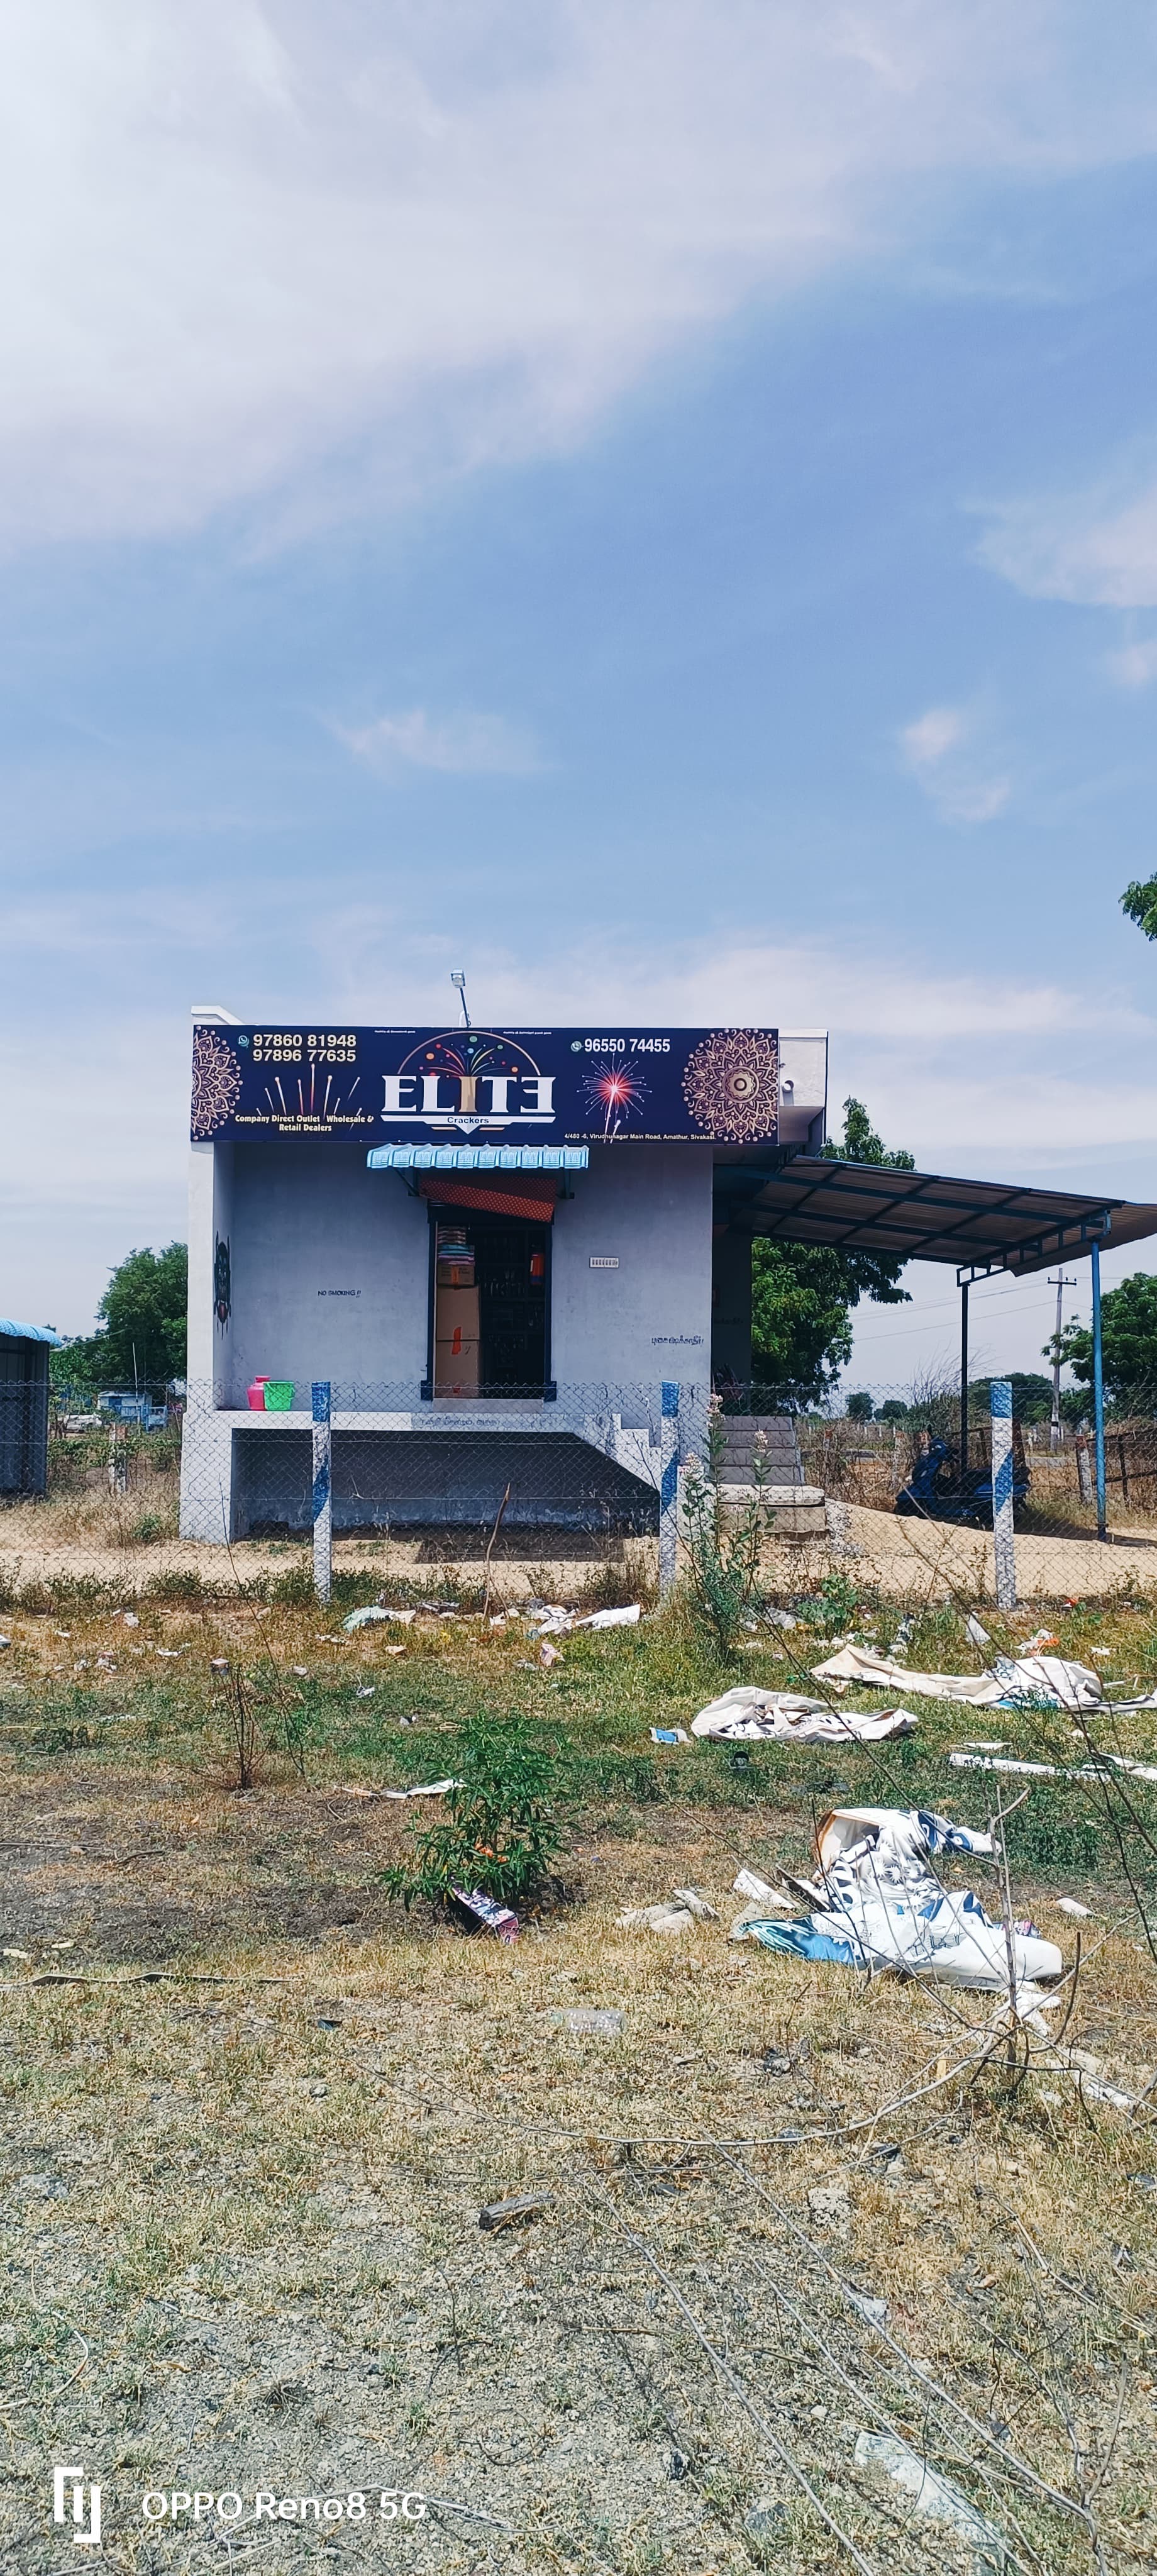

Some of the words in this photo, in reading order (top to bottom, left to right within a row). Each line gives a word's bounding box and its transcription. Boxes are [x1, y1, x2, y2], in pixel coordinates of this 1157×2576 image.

[253, 1035, 302, 1046] 97860
[307, 1035, 357, 1046] 81948
[584, 1038, 625, 1052] 96550
[629, 1038, 670, 1052] 74455
[253, 1050, 302, 1061] 97896
[307, 1050, 356, 1062] 77635
[381, 1075, 556, 1113] ELITE
[235, 1115, 270, 1123] Company
